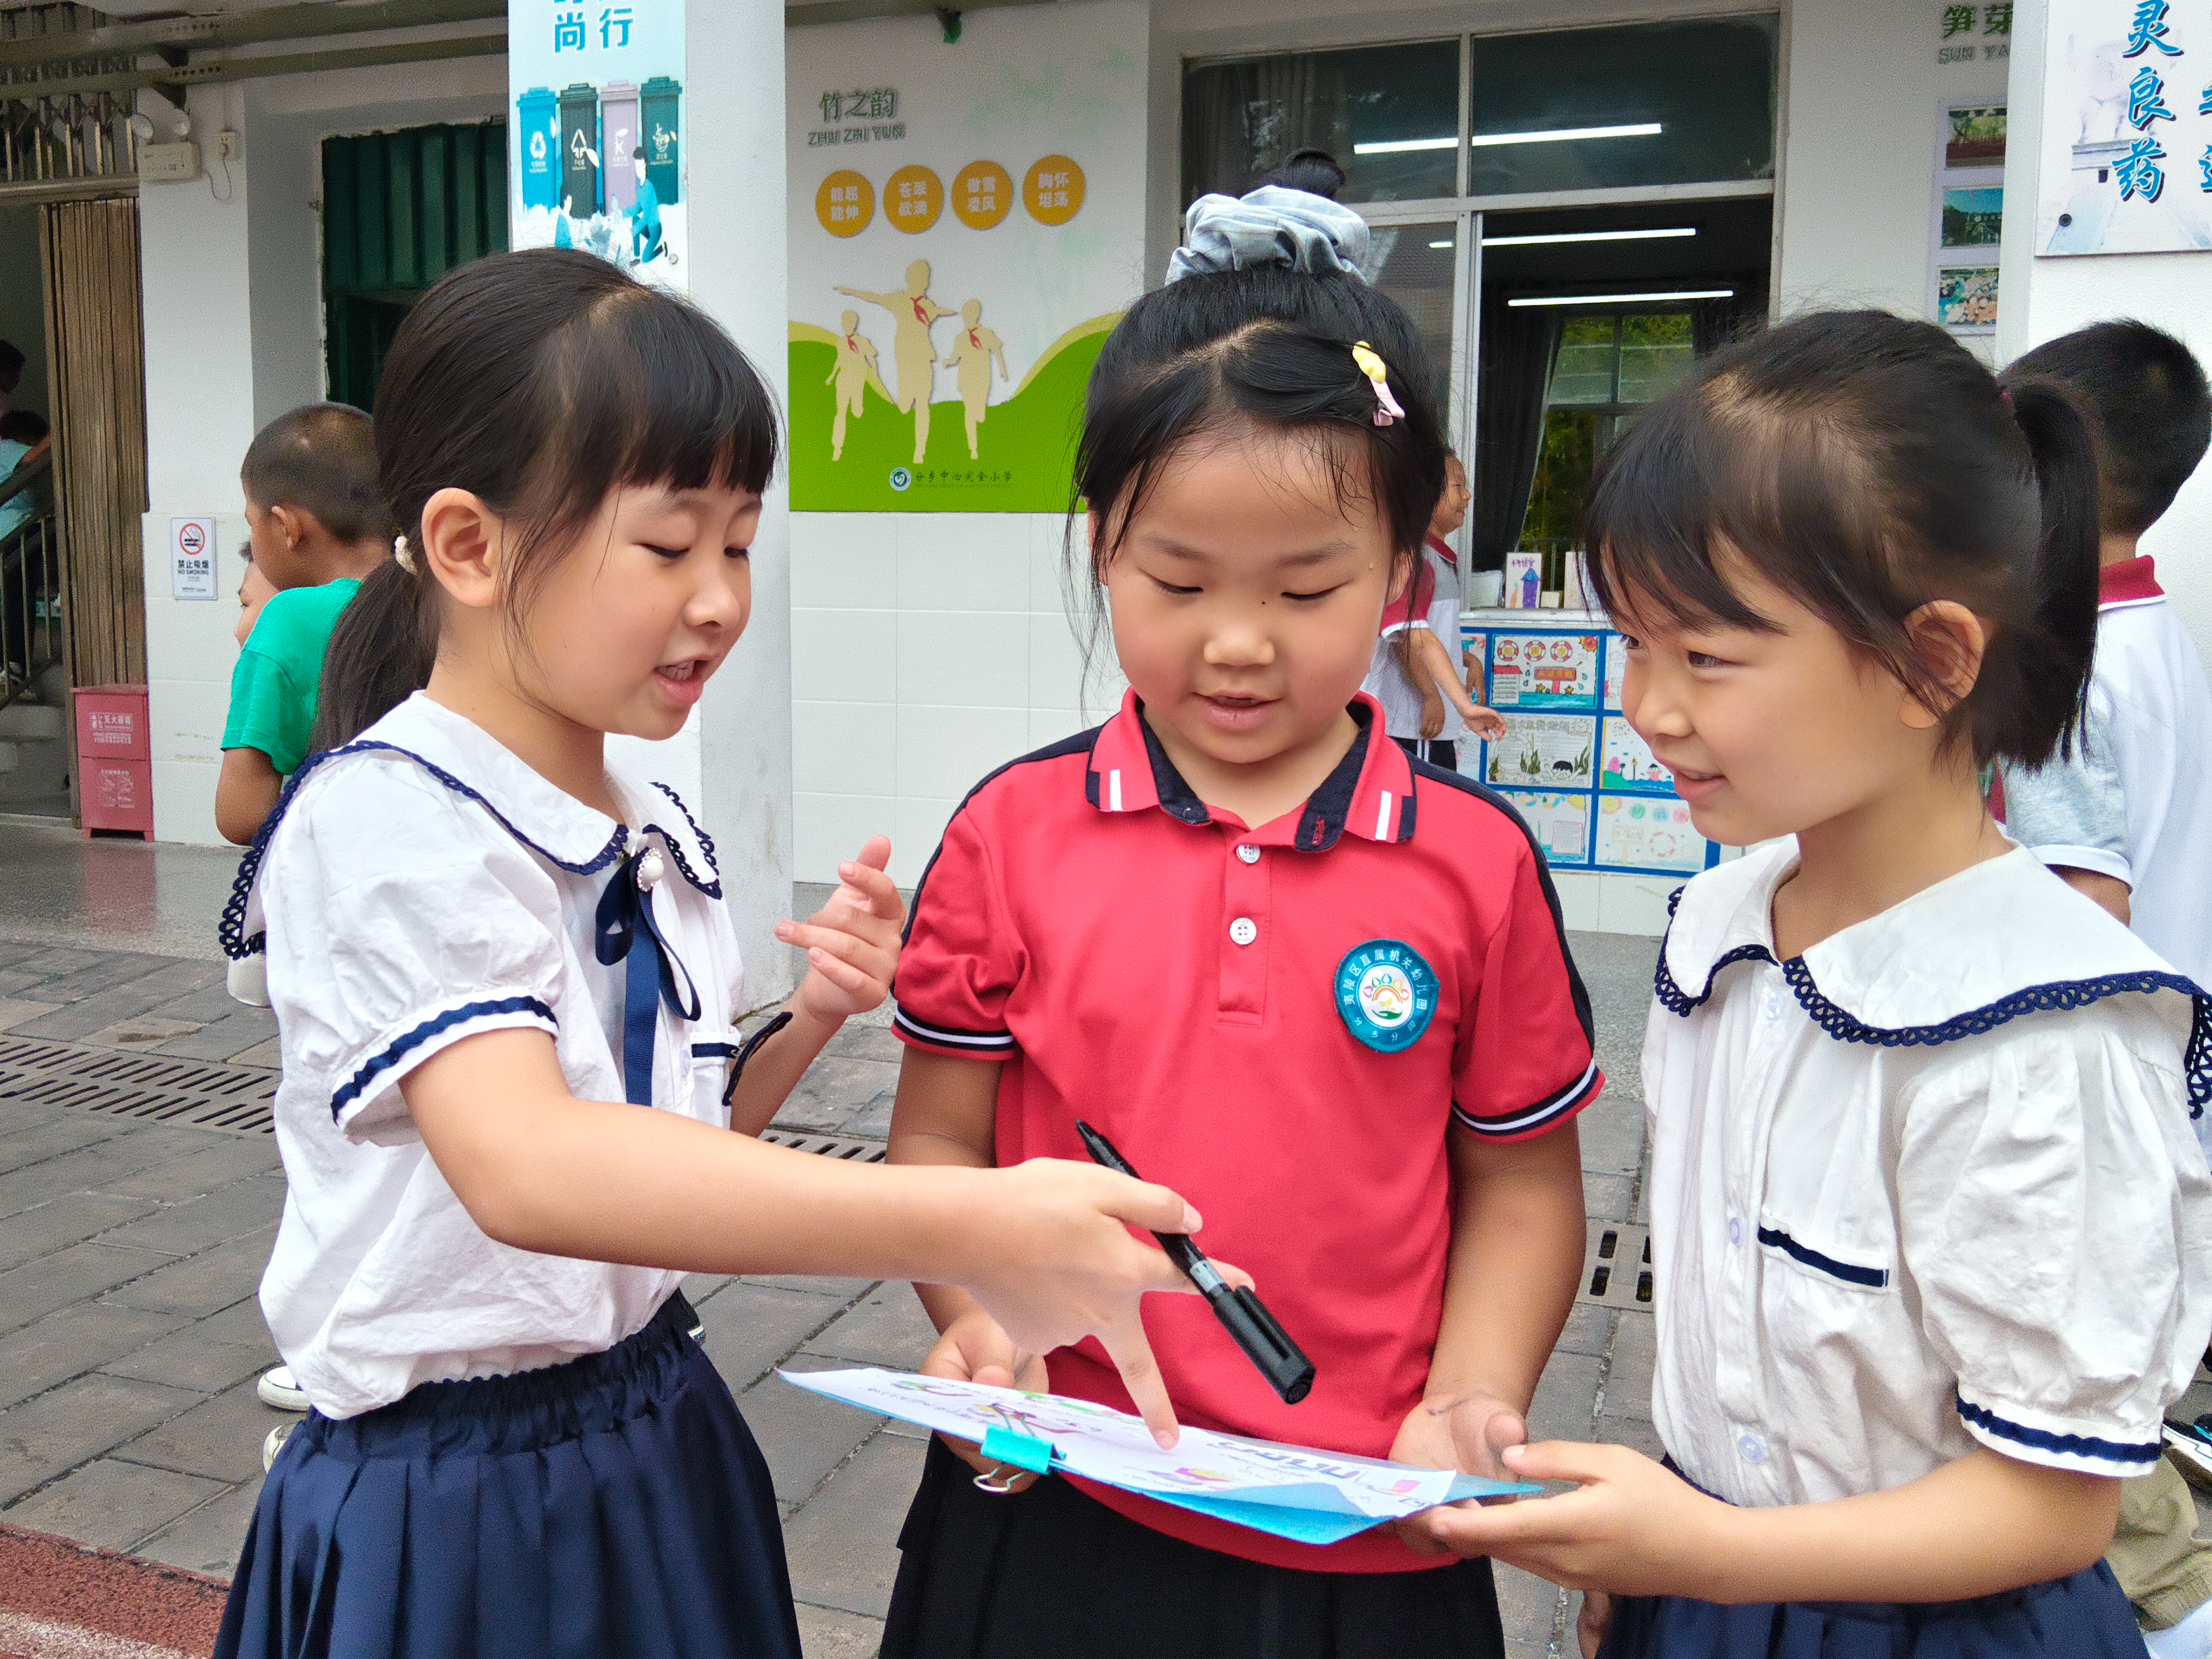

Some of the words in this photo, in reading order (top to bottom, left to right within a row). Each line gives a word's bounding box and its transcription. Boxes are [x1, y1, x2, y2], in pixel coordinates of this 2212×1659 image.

[555, 8, 633, 53] 尚行
[1938, 46, 1975, 63] SUN
[820, 90, 895, 122] 竹之韵
[2112, 0, 2184, 203] 灵良药
[808, 130, 839, 145] ZHU
[872, 123, 905, 140] YUN
